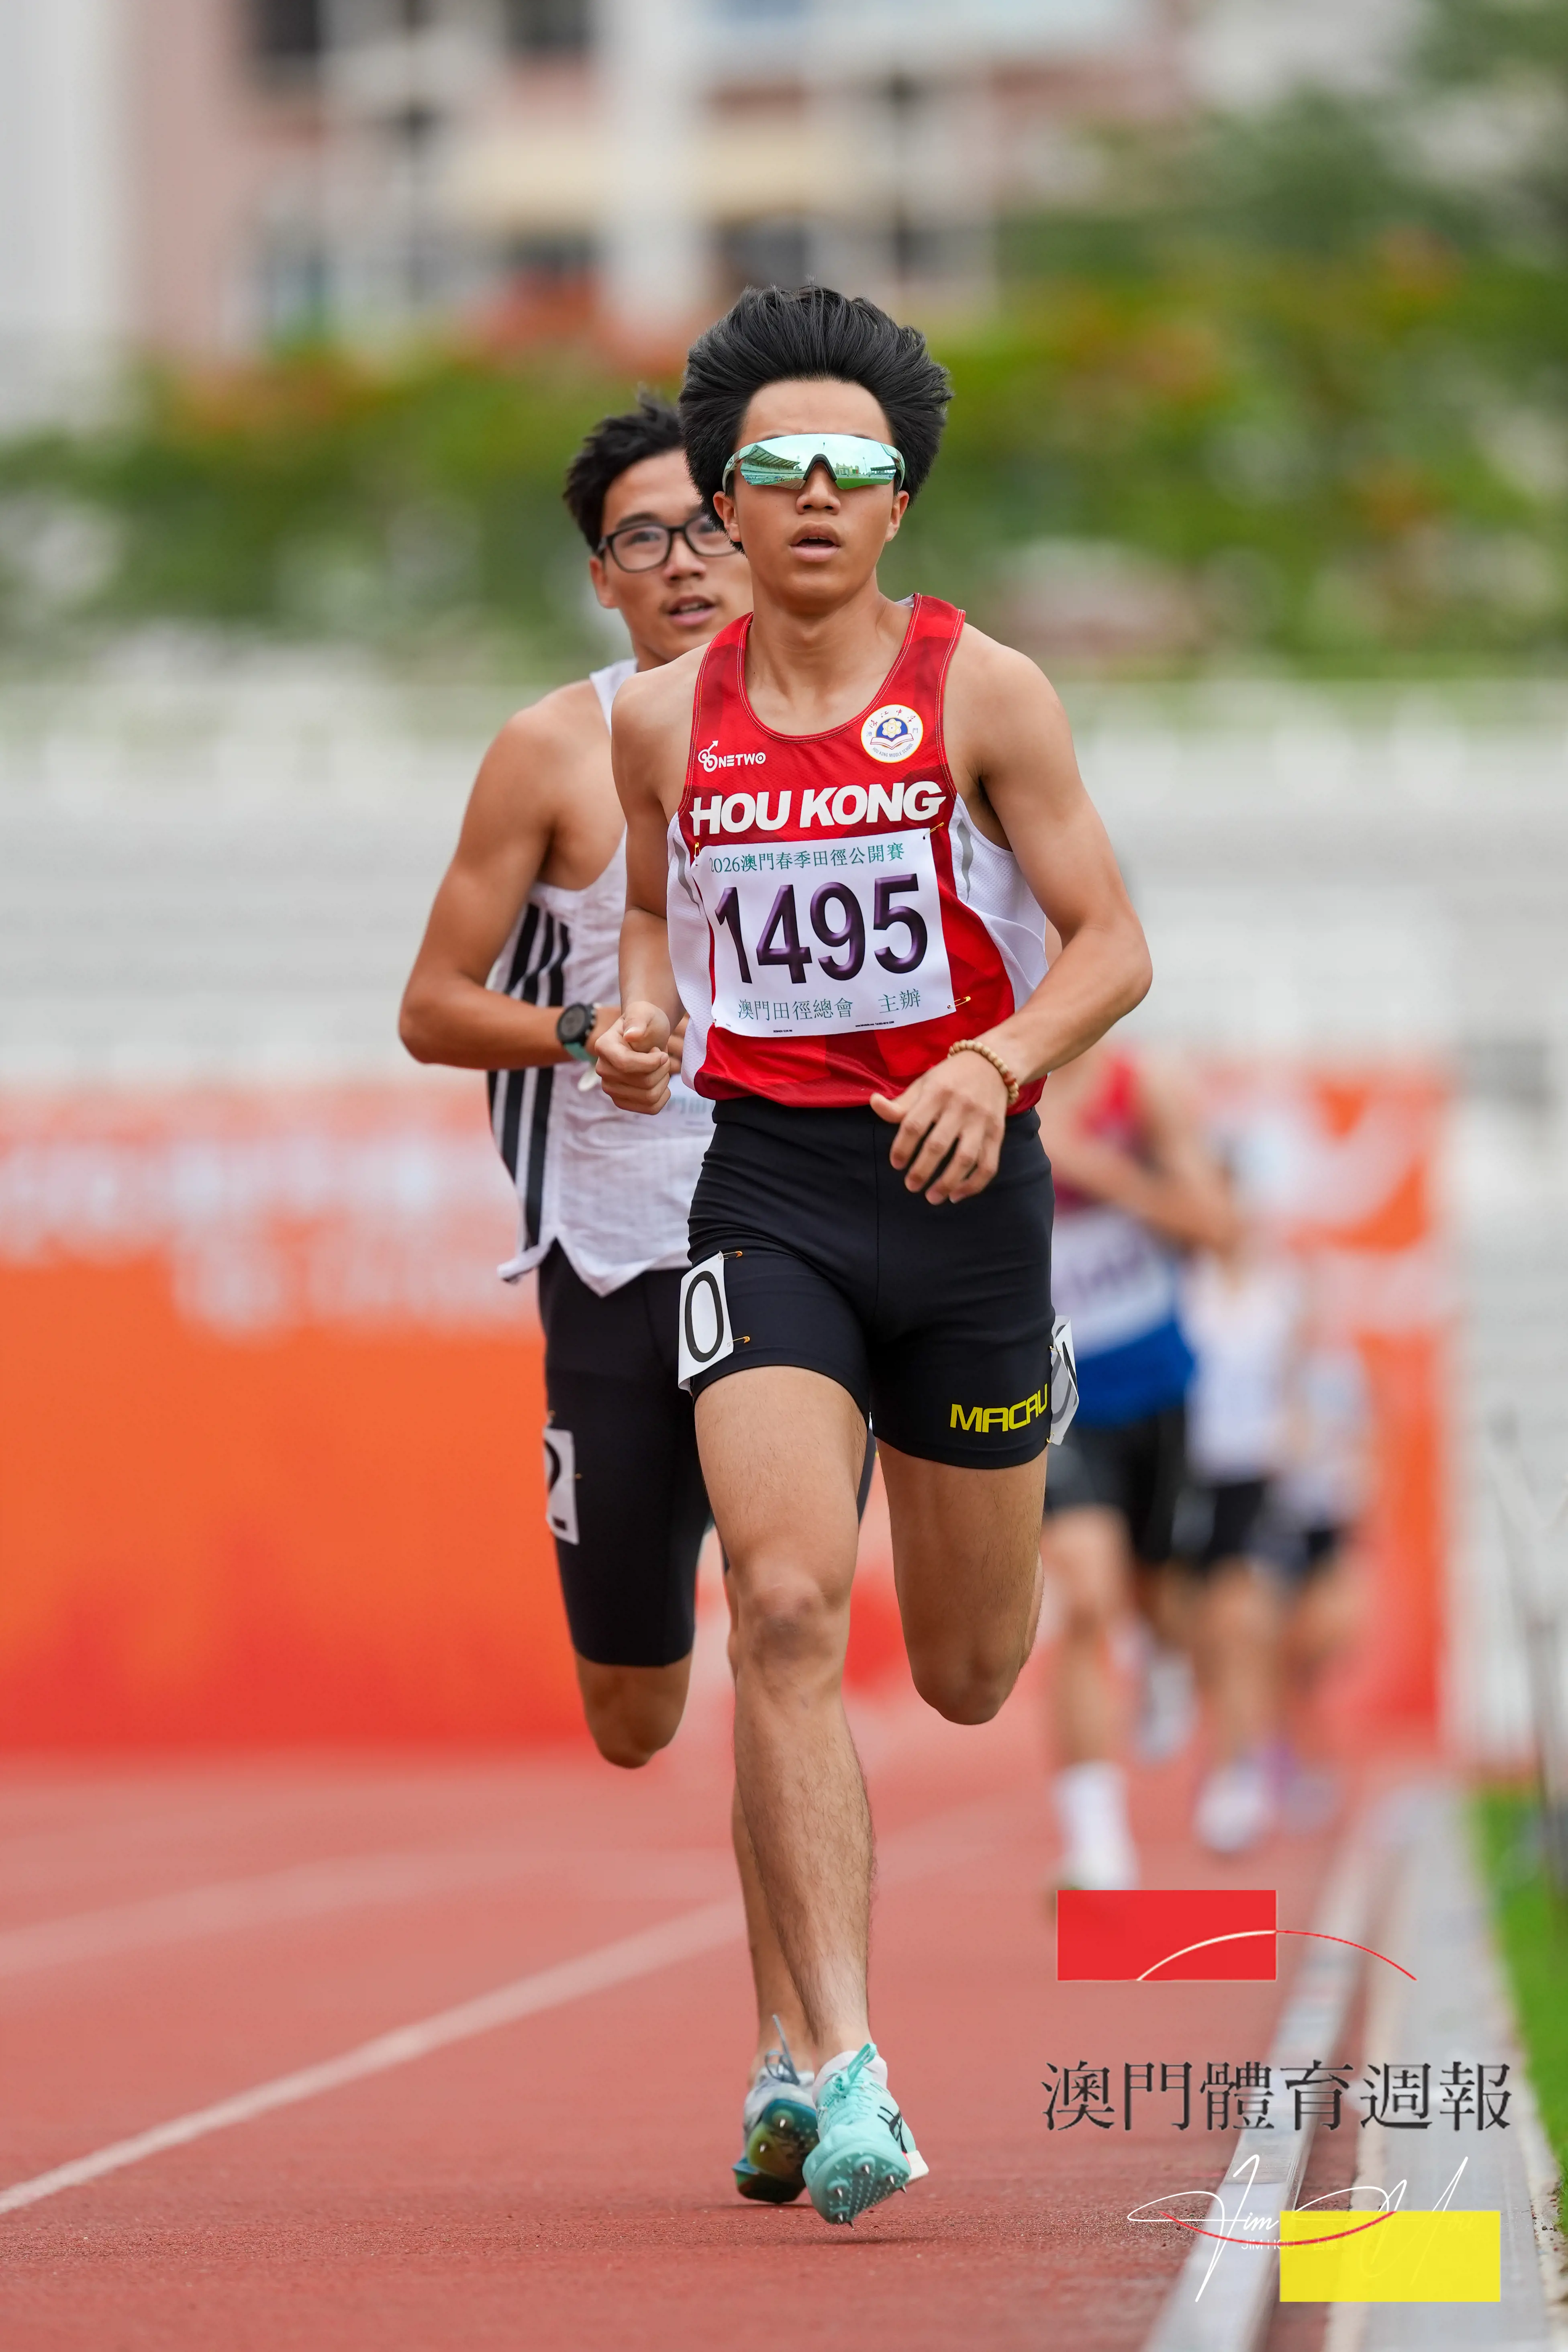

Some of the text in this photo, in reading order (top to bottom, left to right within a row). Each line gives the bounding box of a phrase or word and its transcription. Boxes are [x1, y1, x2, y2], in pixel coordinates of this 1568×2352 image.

[902, 743, 914, 754] SCHOOL
[689, 781, 947, 836] HOU KONG
[709, 842, 905, 873] 2026澳門春季田徑公開賽
[714, 873, 928, 984] 1495
[738, 988, 921, 1021] 澳門田徑總會 主辦
[684, 1270, 723, 1362] 0
[950, 1383, 1048, 1433] MACAU
